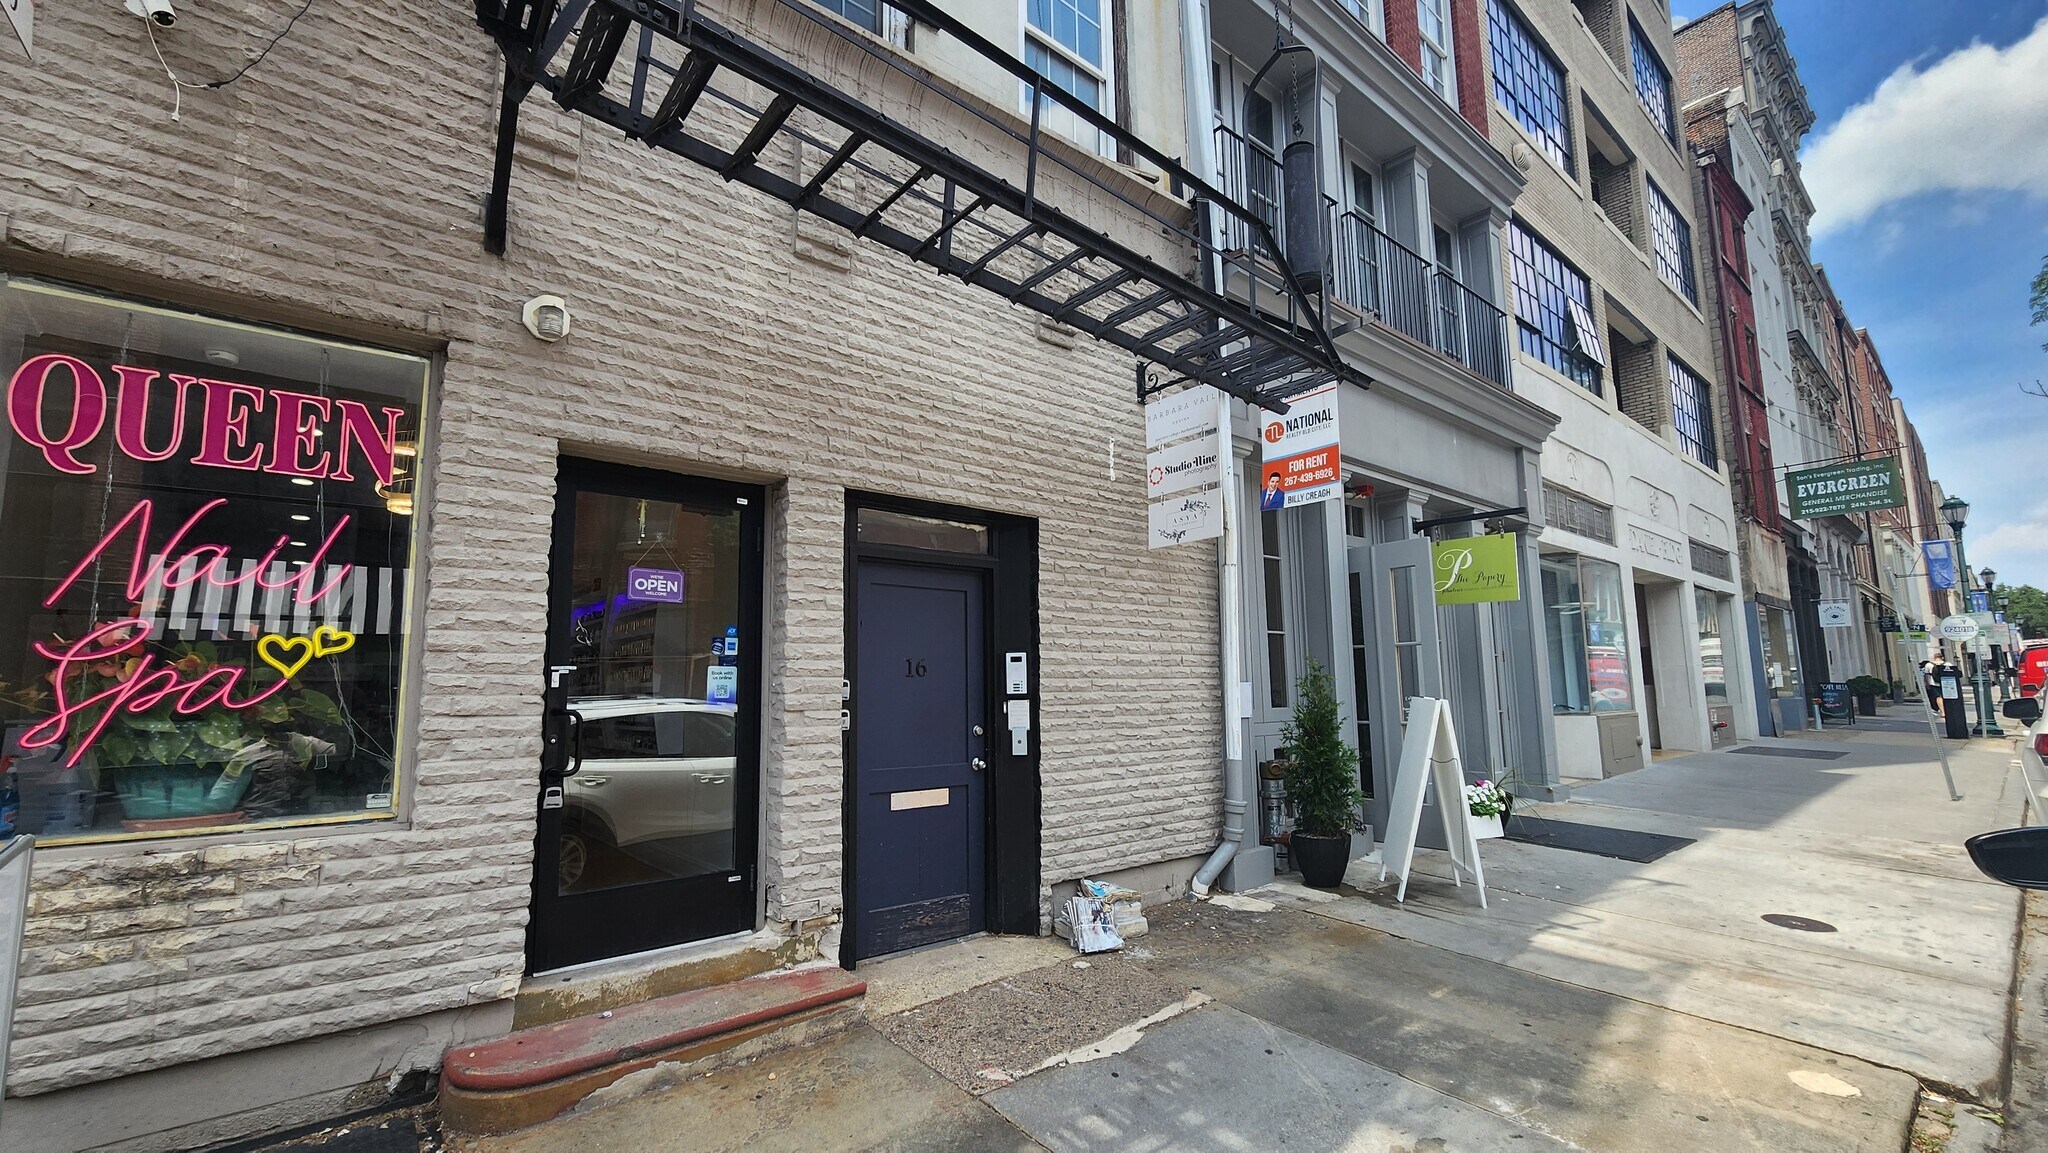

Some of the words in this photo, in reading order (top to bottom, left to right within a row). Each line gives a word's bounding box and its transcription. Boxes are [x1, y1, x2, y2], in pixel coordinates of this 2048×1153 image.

[1147, 402, 1189, 422] BARBARA
[1194, 394, 1216, 405] VAIL
[8, 354, 404, 486] QUEEN
[1286, 408, 1334, 433] NATIONAL
[1165, 460, 1192, 475] Studio
[1193, 454, 1217, 467] Nine
[1184, 463, 1217, 476] photography
[1288, 459, 1304, 473] FOR
[1306, 453, 1328, 469] RENT
[1284, 467, 1333, 487] 267-439-6926
[1813, 468, 1845, 479] Evergreen
[1797, 472, 1890, 498] EVERGREEN
[1287, 493, 1304, 504] BILLY
[1305, 488, 1331, 501] CREAGH
[1802, 497, 1834, 507] GENERAL
[1835, 489, 1888, 502] MERCHANDISE
[42, 498, 354, 609] Nail
[634, 578, 678, 593] OPEN
[905, 658, 928, 678] 16
[19, 618, 290, 769] Spa
